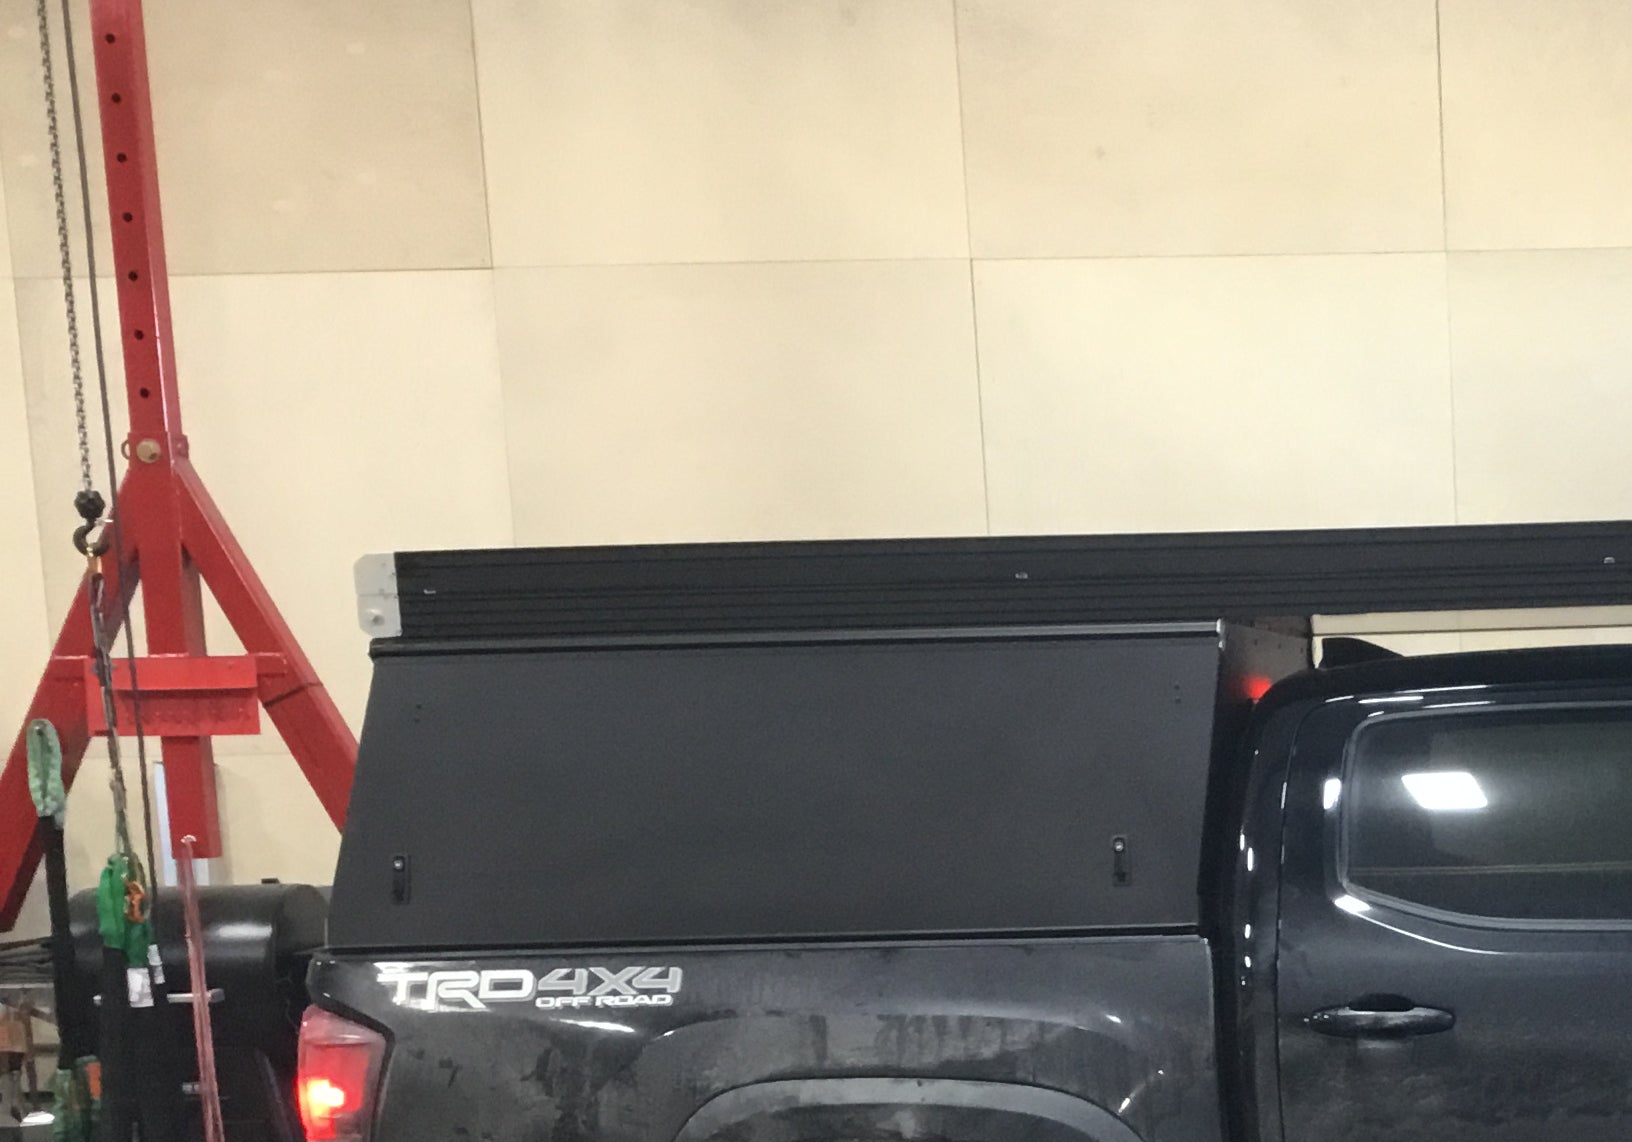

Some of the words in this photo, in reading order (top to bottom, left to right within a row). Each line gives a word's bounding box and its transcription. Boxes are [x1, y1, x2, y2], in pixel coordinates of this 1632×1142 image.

[377, 968, 537, 1012] TRD
[535, 996, 590, 1009] OFF
[595, 994, 674, 1008] ROAD
